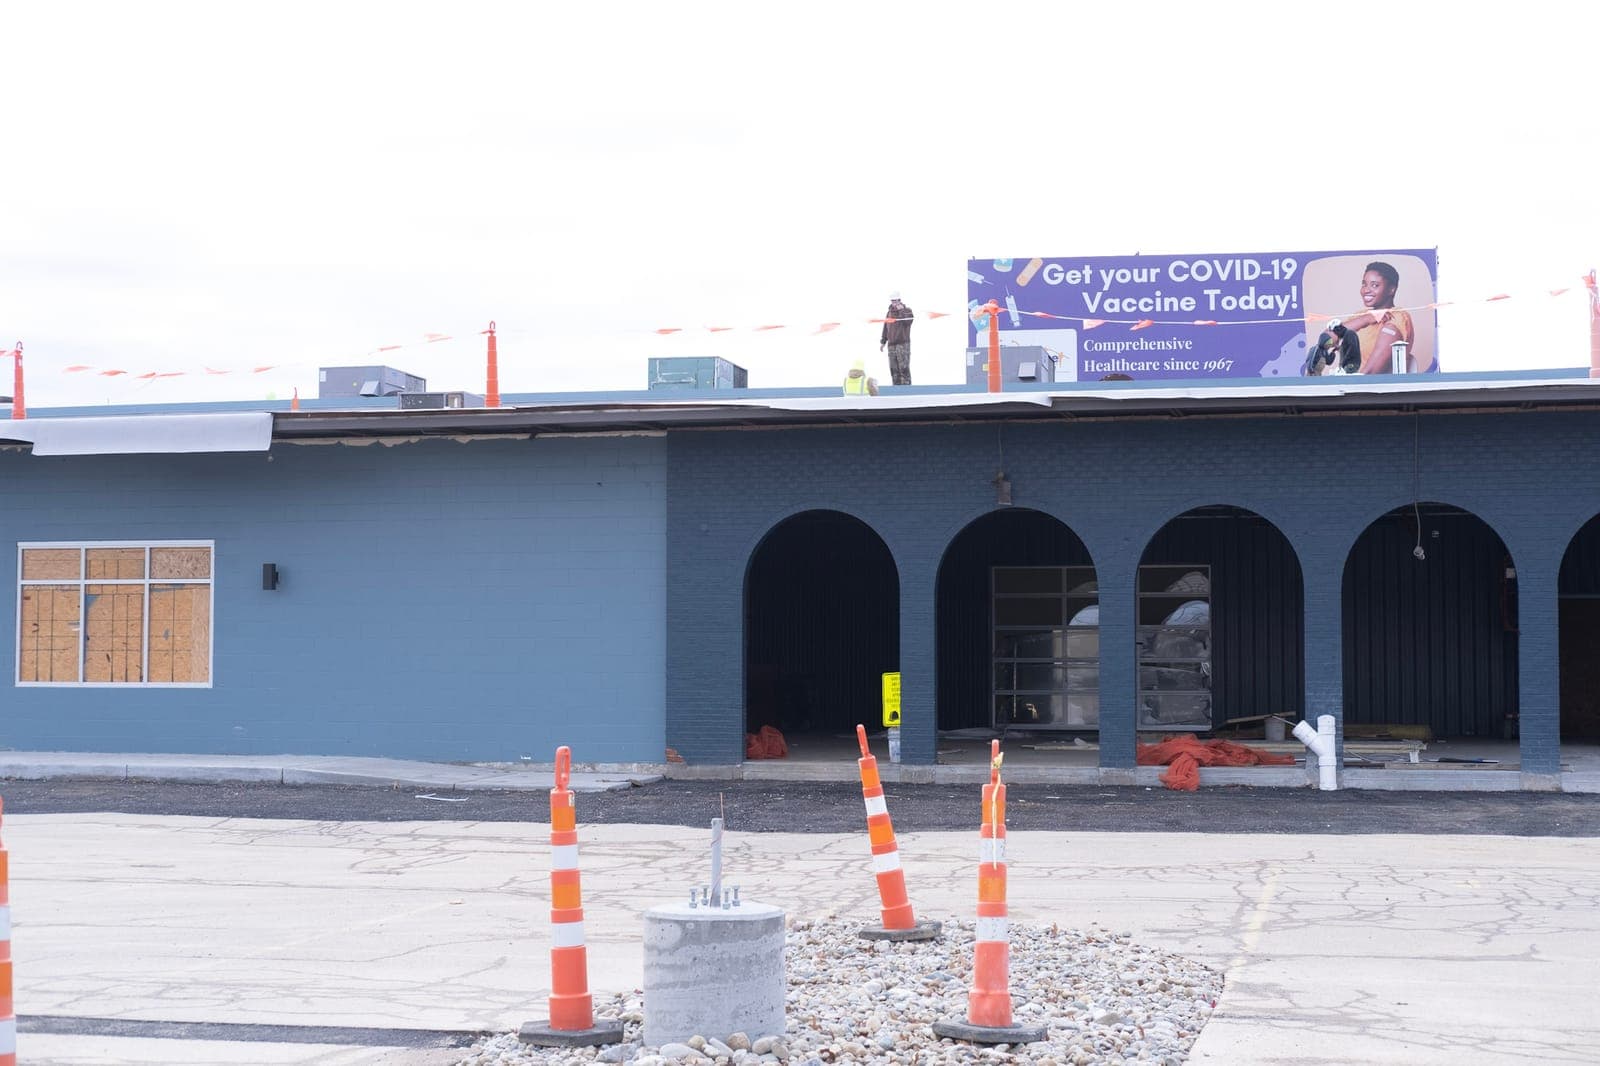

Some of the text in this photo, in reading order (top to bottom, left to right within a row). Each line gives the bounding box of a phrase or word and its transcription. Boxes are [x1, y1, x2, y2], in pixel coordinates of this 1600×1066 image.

[1042, 258, 1298, 291] Get your COVID-19
[1082, 285, 1298, 316] Vaccine Today!
[1083, 337, 1192, 353] Comprehensive
[1084, 358, 1160, 372] Healthcare
[1163, 358, 1199, 371] since
[1203, 357, 1234, 372] 1967
